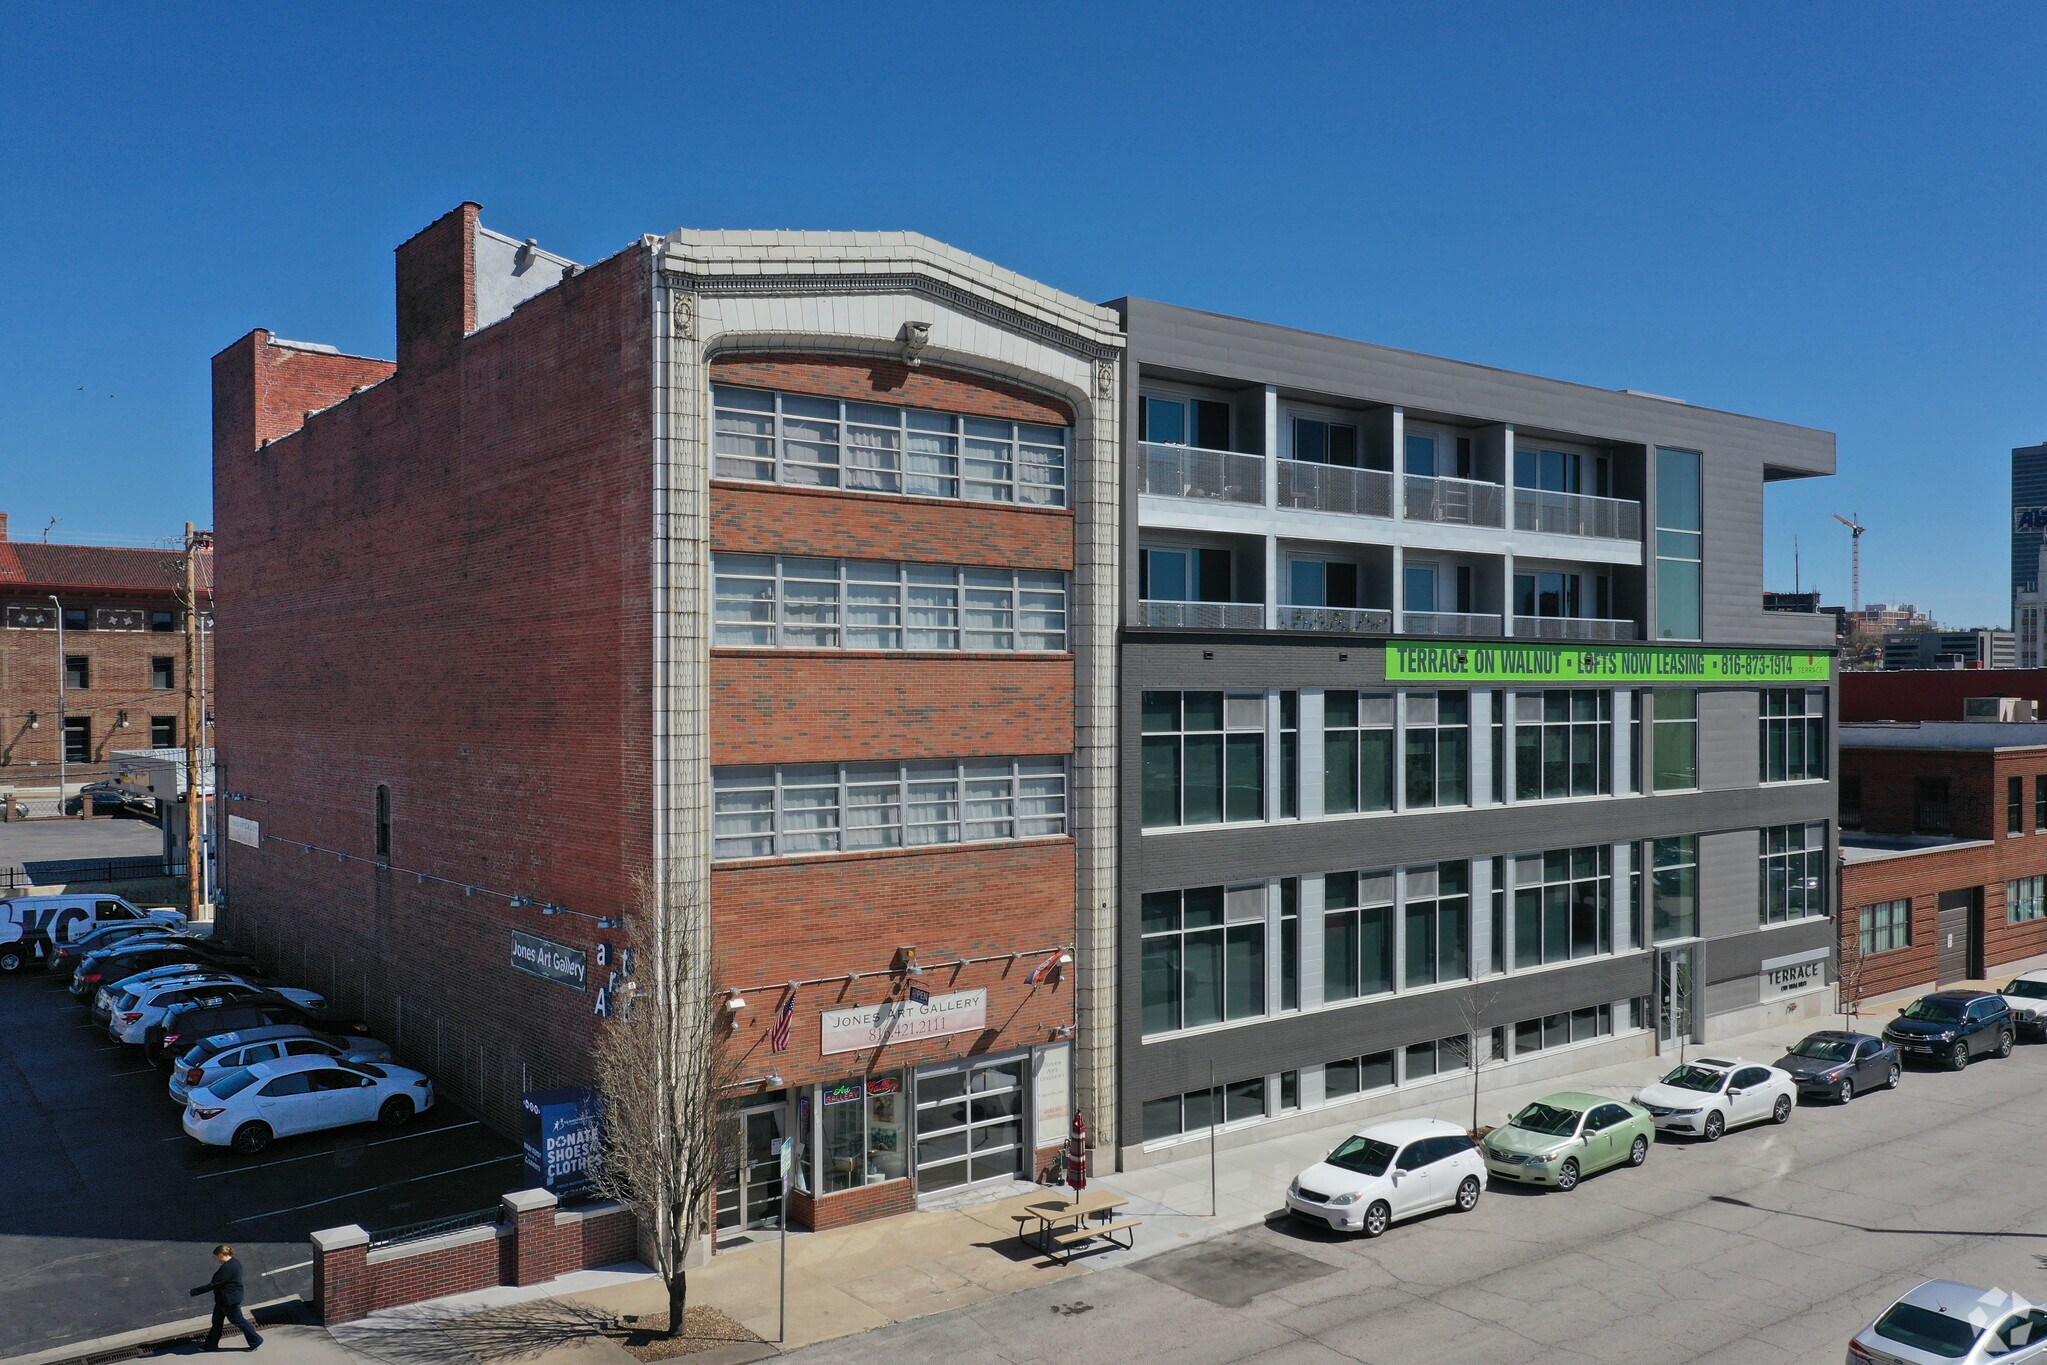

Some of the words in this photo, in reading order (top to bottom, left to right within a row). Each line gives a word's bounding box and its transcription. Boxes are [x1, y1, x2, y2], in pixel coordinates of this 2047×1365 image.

[1397, 648, 1468, 673] TERRACE
[1474, 649, 1495, 674] ON
[1501, 650, 1562, 674] WALNUT
[1578, 649, 1617, 675] LOFTS
[1621, 652, 1651, 675] NOW
[1656, 652, 1704, 675] LEASING
[1721, 654, 1793, 675] 816-873-1914
[1798, 666, 1823, 674] TERRACE
[512, 939, 536, 962] Jones
[537, 947, 552, 967] Art
[553, 952, 585, 982] Gallery
[1767, 963, 1819, 986] TERRACE
[911, 988, 928, 1001] OPEN
[833, 1012, 881, 1028] JONES
[887, 1007, 914, 1020] ART
[919, 997, 979, 1015] GALLERY
[868, 1017, 946, 1042] 816.421.2111
[826, 1091, 859, 1103] GALLERY
[546, 1128, 598, 1151] DONATE
[547, 1143, 589, 1164] SHOES
[547, 1154, 602, 1177] CLOTHES
